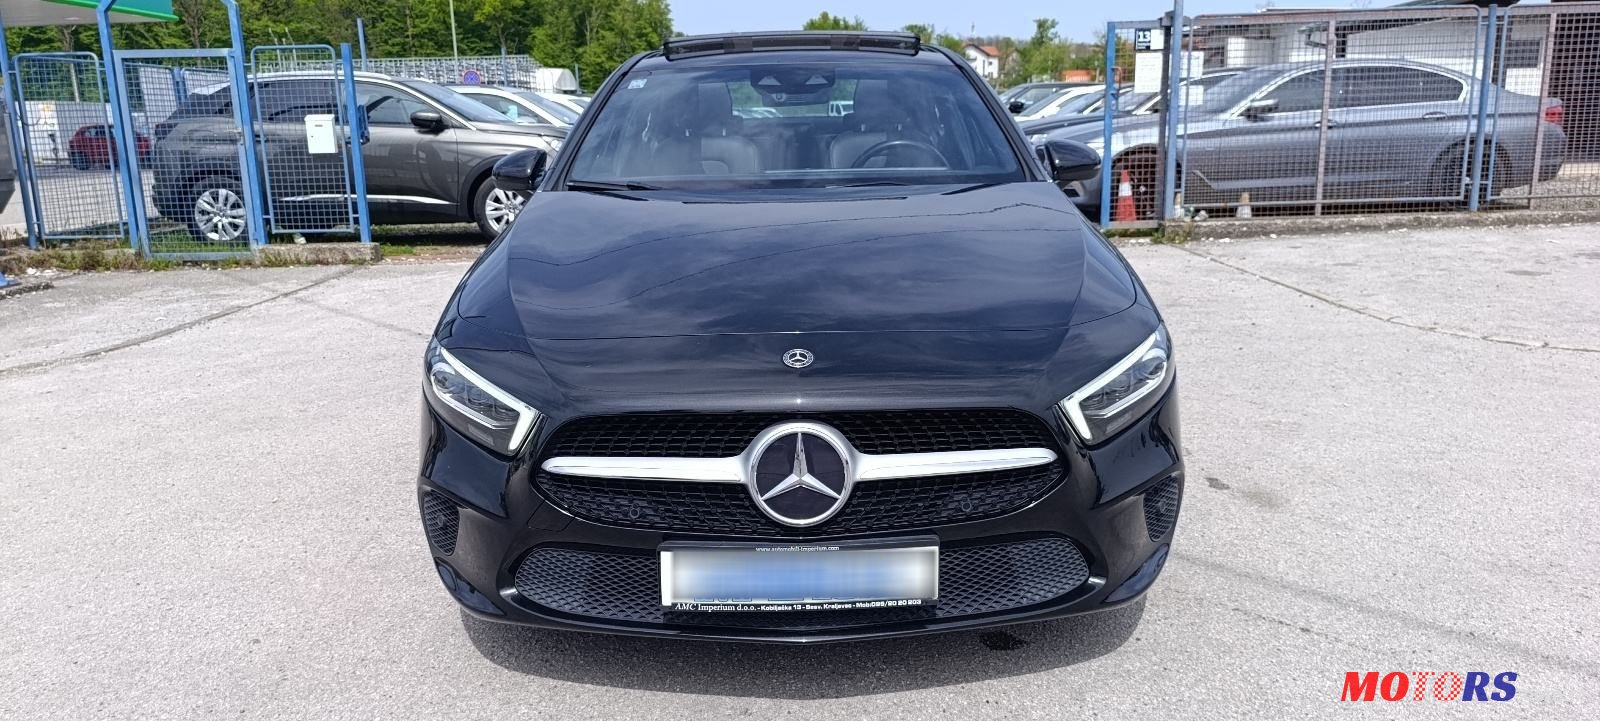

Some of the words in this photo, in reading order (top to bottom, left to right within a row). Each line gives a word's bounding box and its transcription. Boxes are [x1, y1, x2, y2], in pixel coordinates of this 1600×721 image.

[1138, 31, 1151, 42] 13
[675, 602, 696, 611] AMC
[698, 603, 735, 612] Imperium
[737, 603, 756, 611] d.o.o.
